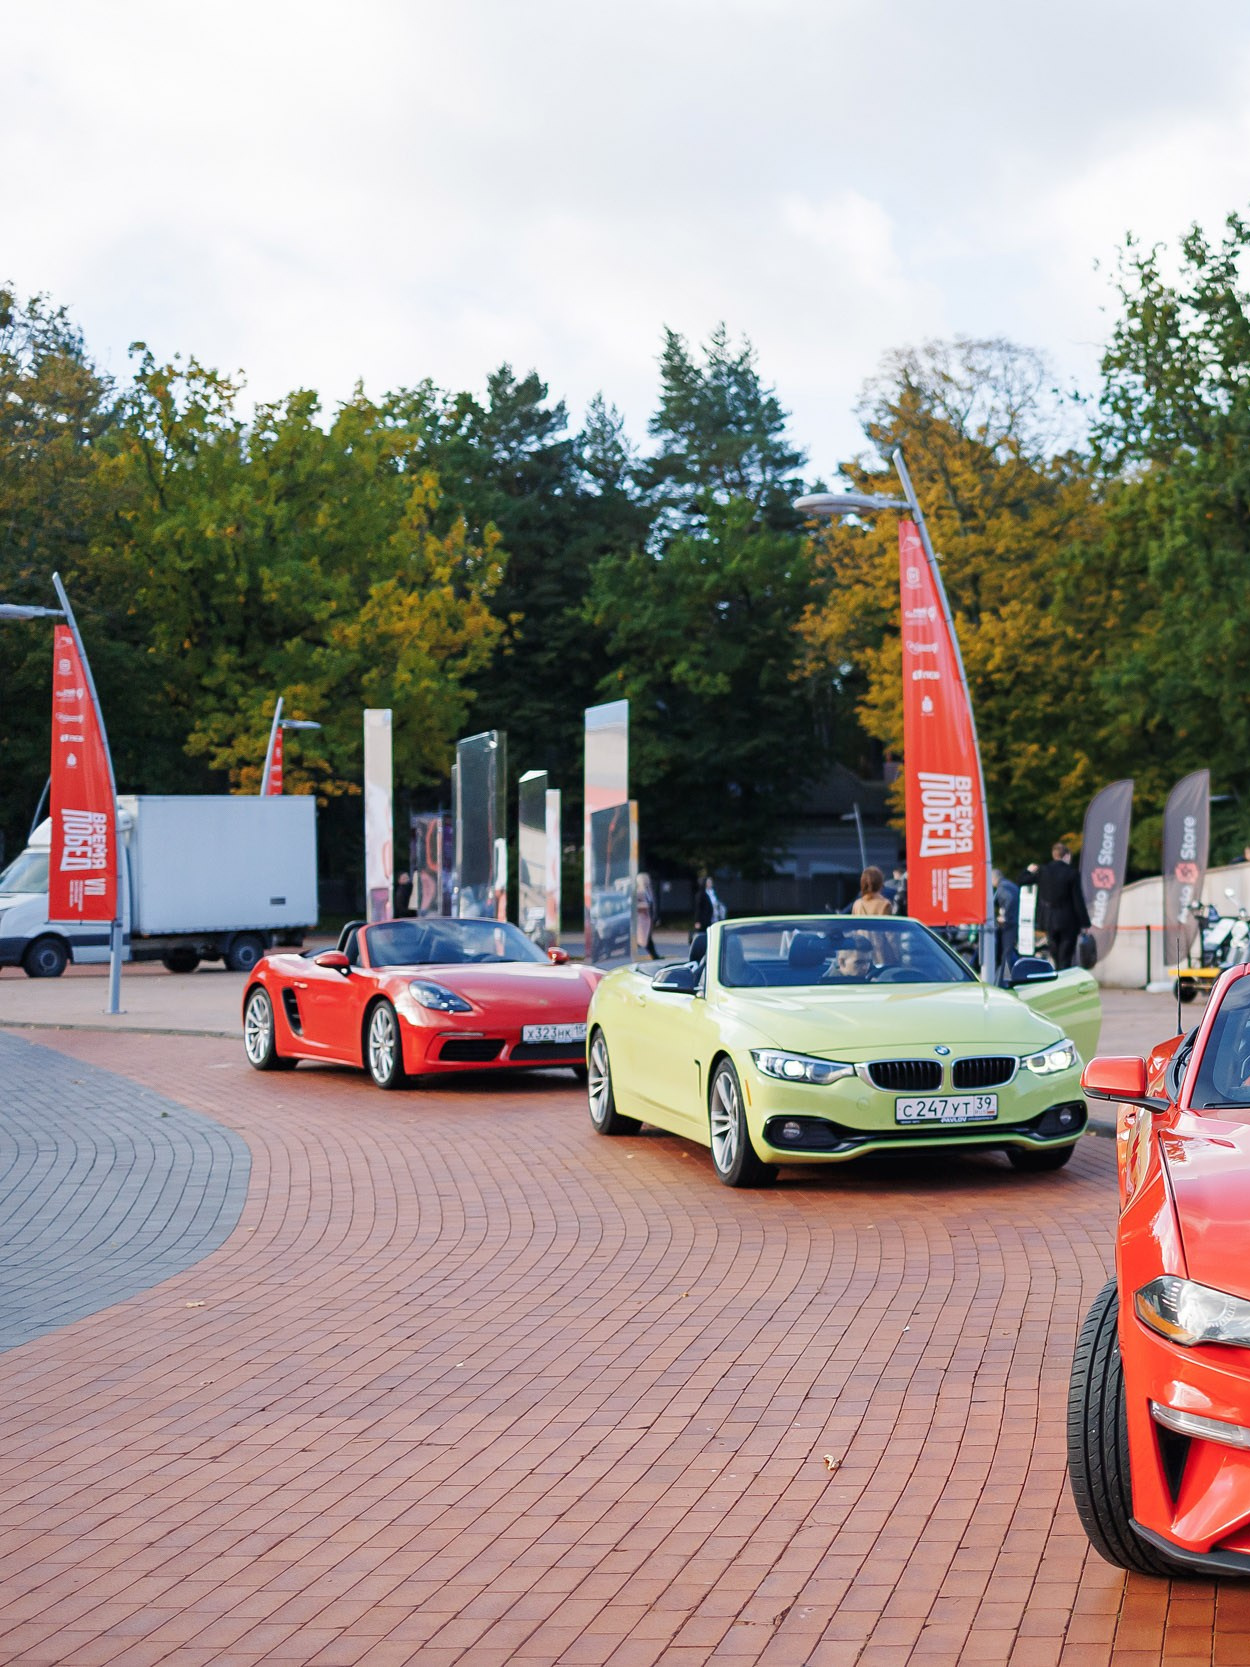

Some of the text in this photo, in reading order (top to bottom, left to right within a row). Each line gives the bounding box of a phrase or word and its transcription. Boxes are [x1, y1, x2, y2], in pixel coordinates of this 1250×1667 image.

[60, 808, 93, 871] ПОБЕД
[917, 771, 956, 857] ПОБЕД
[956, 775, 975, 854] ВРЕМЯ
[1180, 816, 1197, 861] Store
[92, 812, 108, 870] ВРЕМЯ
[1097, 822, 1116, 866] Store
[948, 865, 973, 889] VII
[903, 1096, 992, 1118] С247УТ 39
